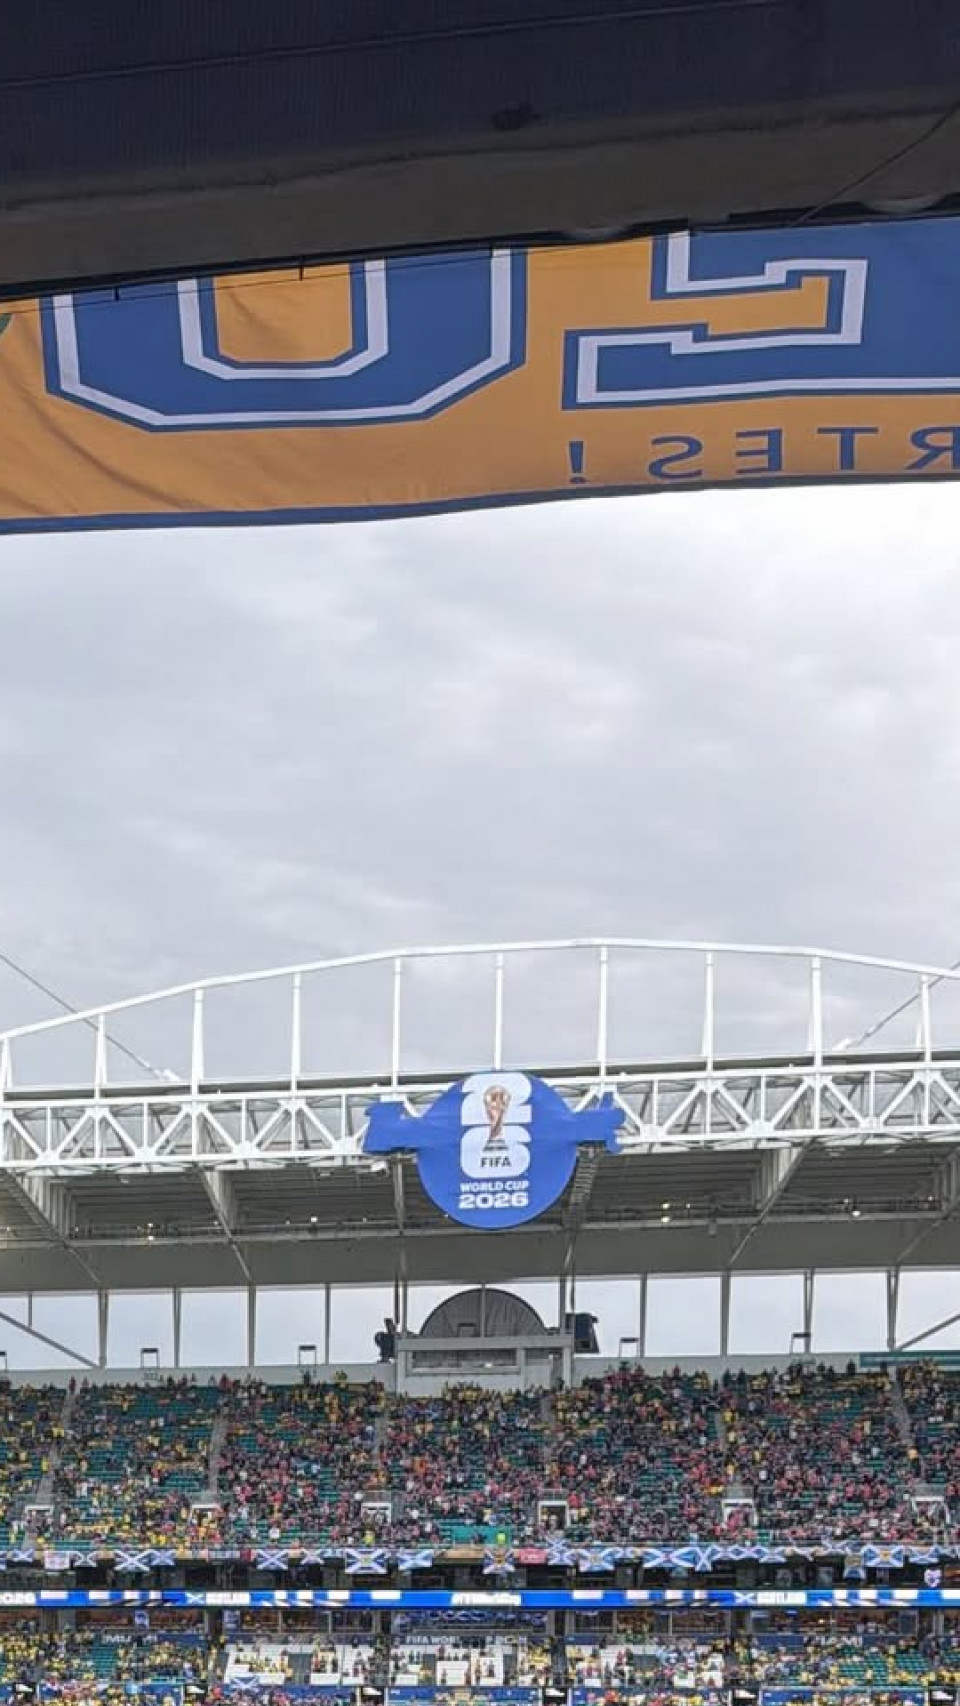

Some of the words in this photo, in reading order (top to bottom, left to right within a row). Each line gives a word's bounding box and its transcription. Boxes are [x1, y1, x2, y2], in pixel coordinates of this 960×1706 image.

[479, 1157, 512, 1169] FIFA
[459, 1181, 503, 1193] WORLD
[505, 1180, 529, 1191] CUP
[458, 1192, 529, 1209] 2026
